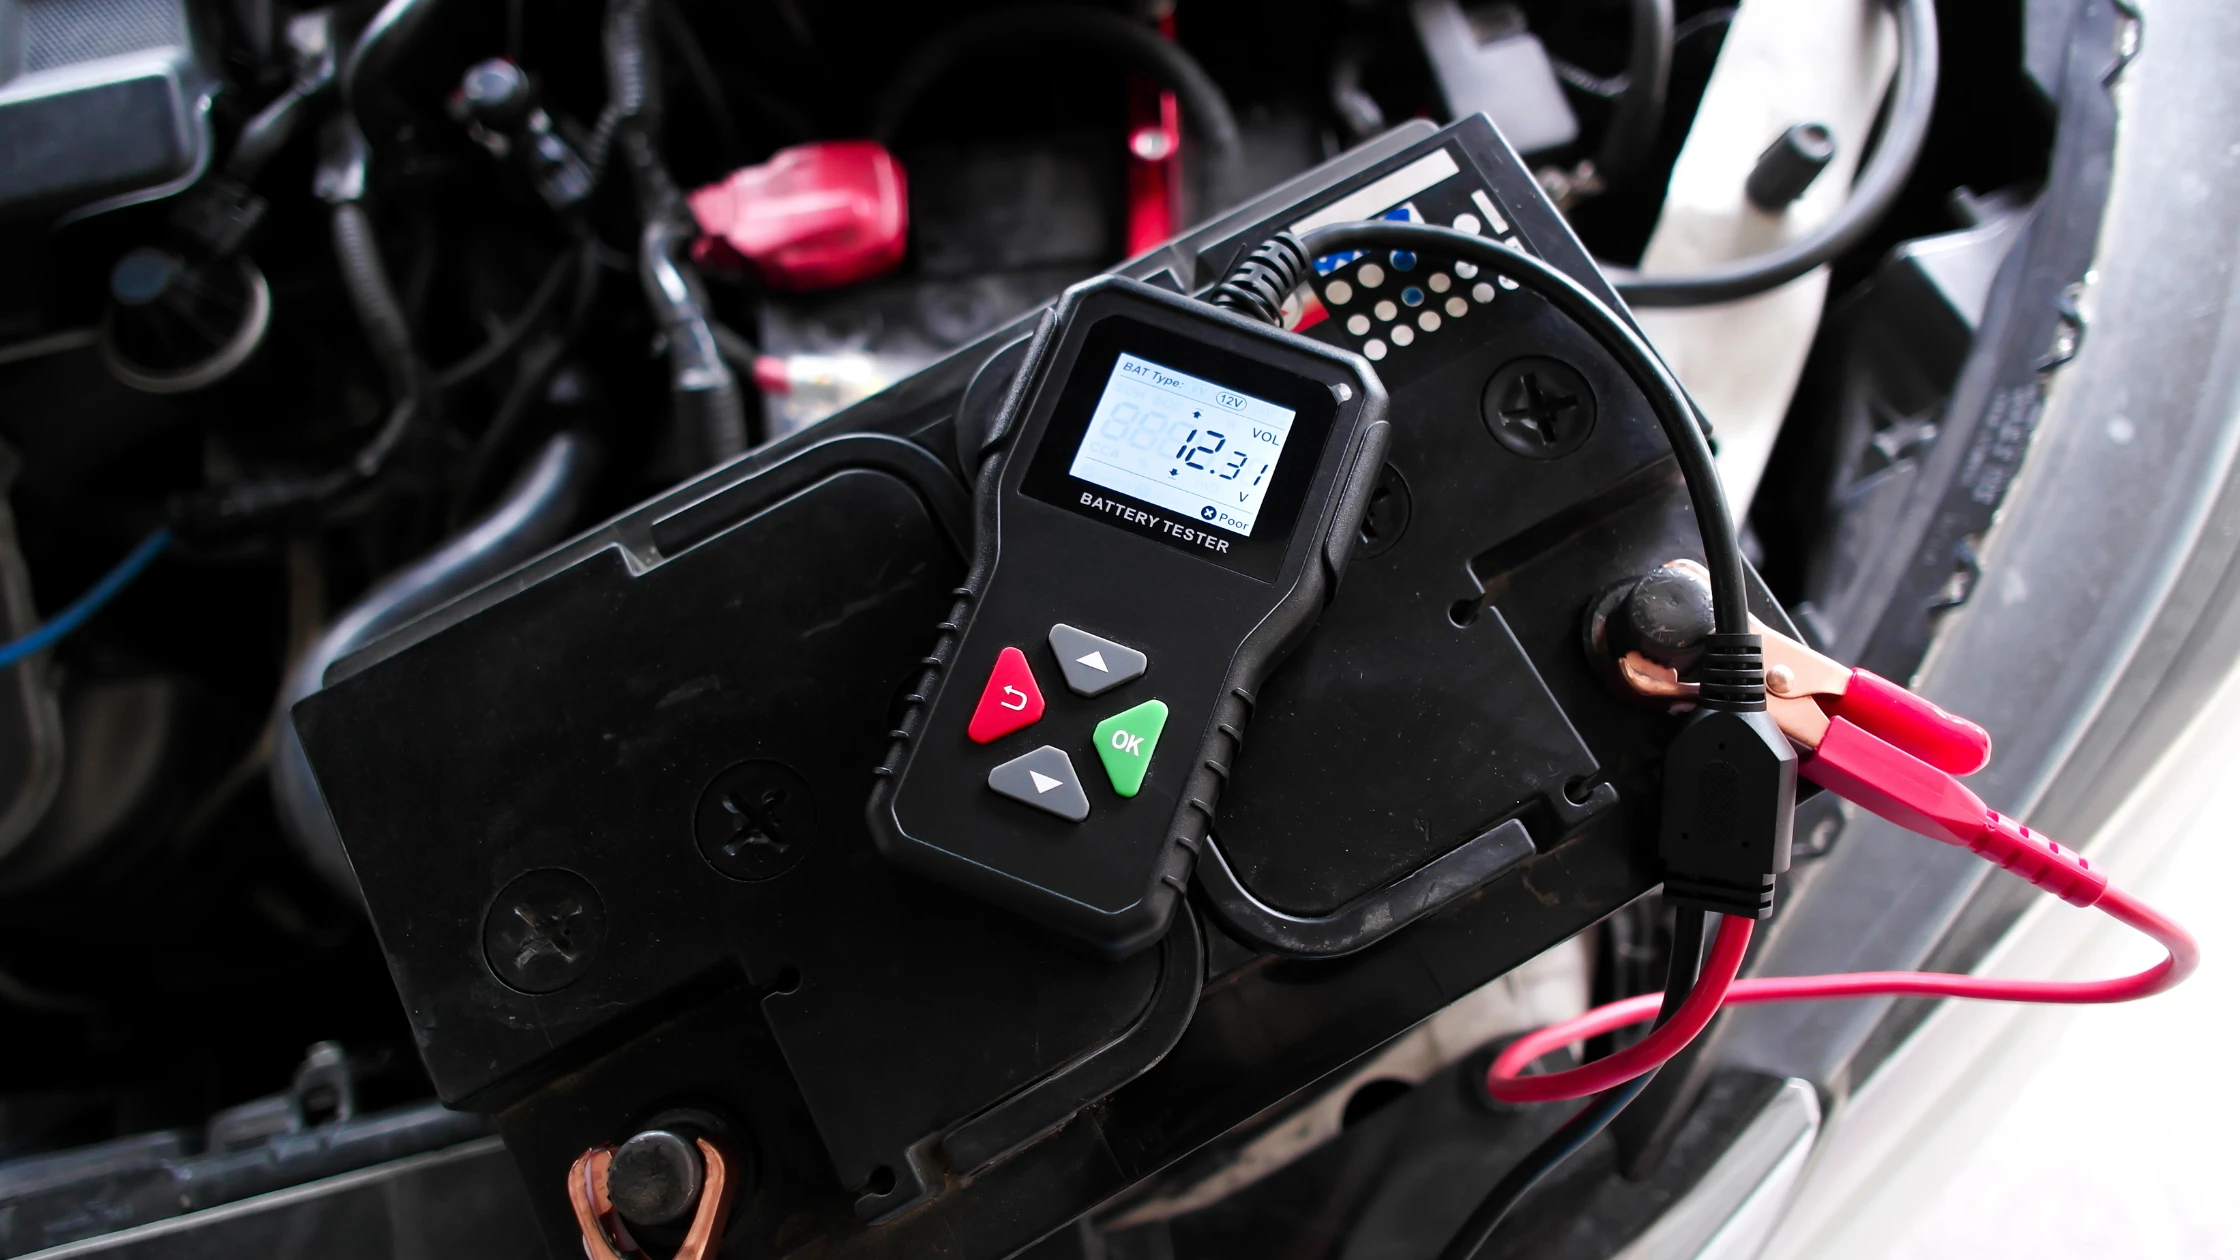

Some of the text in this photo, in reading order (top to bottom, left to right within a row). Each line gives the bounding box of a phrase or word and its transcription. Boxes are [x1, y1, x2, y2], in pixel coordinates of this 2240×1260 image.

[1122, 361, 1151, 377] BAT
[1152, 370, 1185, 389] Type:
[1219, 393, 1245, 408] 12V
[1252, 427, 1280, 446] VOL
[1175, 428, 1269, 487] 12.31
[1238, 491, 1250, 503] V
[1080, 492, 1230, 554] BATTERY TESTER
[1218, 513, 1250, 531] Poor
[1111, 730, 1145, 757] OK
